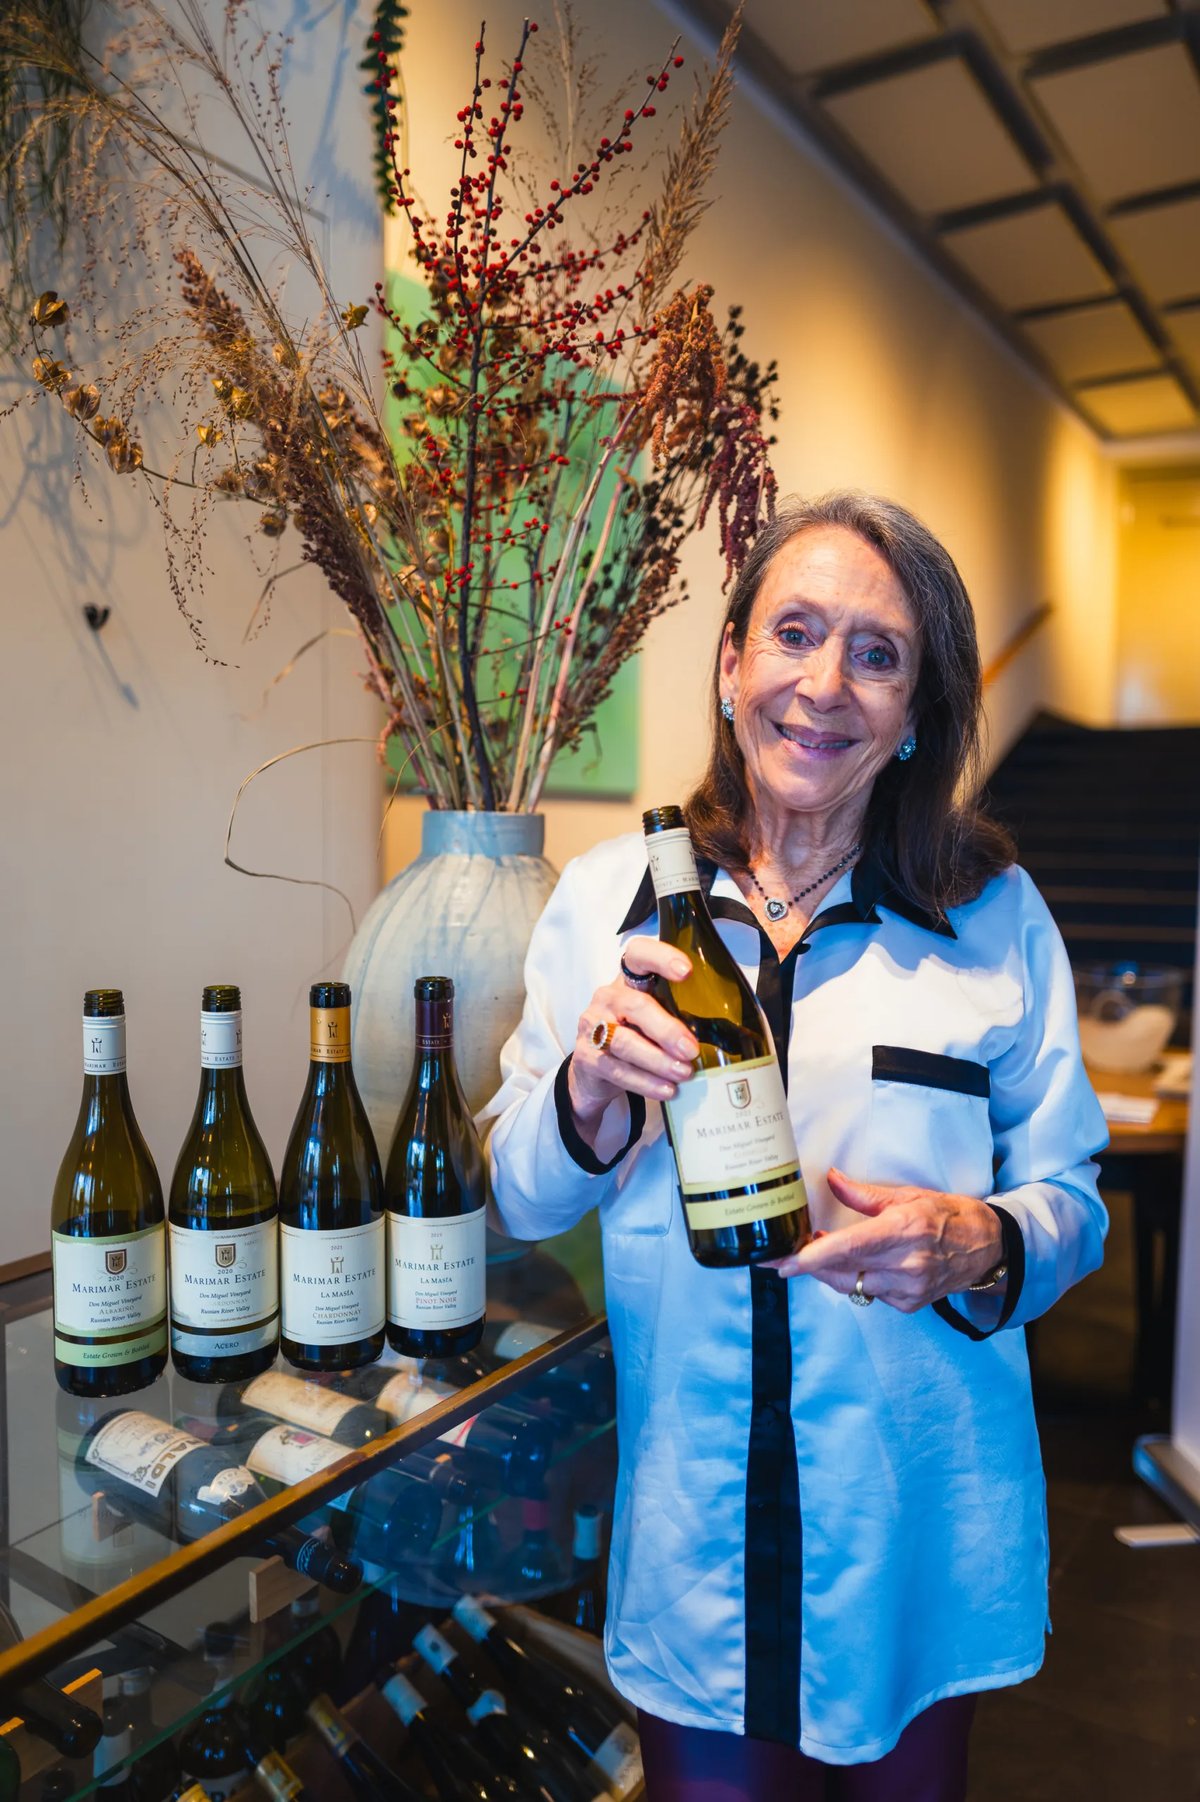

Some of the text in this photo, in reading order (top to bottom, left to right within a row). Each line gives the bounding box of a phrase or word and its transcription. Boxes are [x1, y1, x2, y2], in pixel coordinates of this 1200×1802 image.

[696, 1111, 785, 1138] MARIMAR ESTATE
[394, 1256, 476, 1271] MARIMAR ESTATE
[108, 1274, 125, 1282] 2020
[184, 1269, 266, 1285] MARIMAR ESTATE
[293, 1267, 376, 1285] MARIMAR ESTATE
[72, 1274, 156, 1294] MARIMAR ESTATE
[211, 1291, 229, 1299] Miguel
[230, 1289, 251, 1298] Vineyard
[101, 1300, 120, 1308] Miguel
[121, 1295, 143, 1305] Vineyard
[439, 1296, 457, 1304] NOIR
[236, 1305, 251, 1313] Valley
[312, 1309, 362, 1319] CHARDONNAY
[127, 1312, 142, 1320] Valley
[131, 1343, 150, 1354] Bottled
[214, 1341, 240, 1350] ACERO
